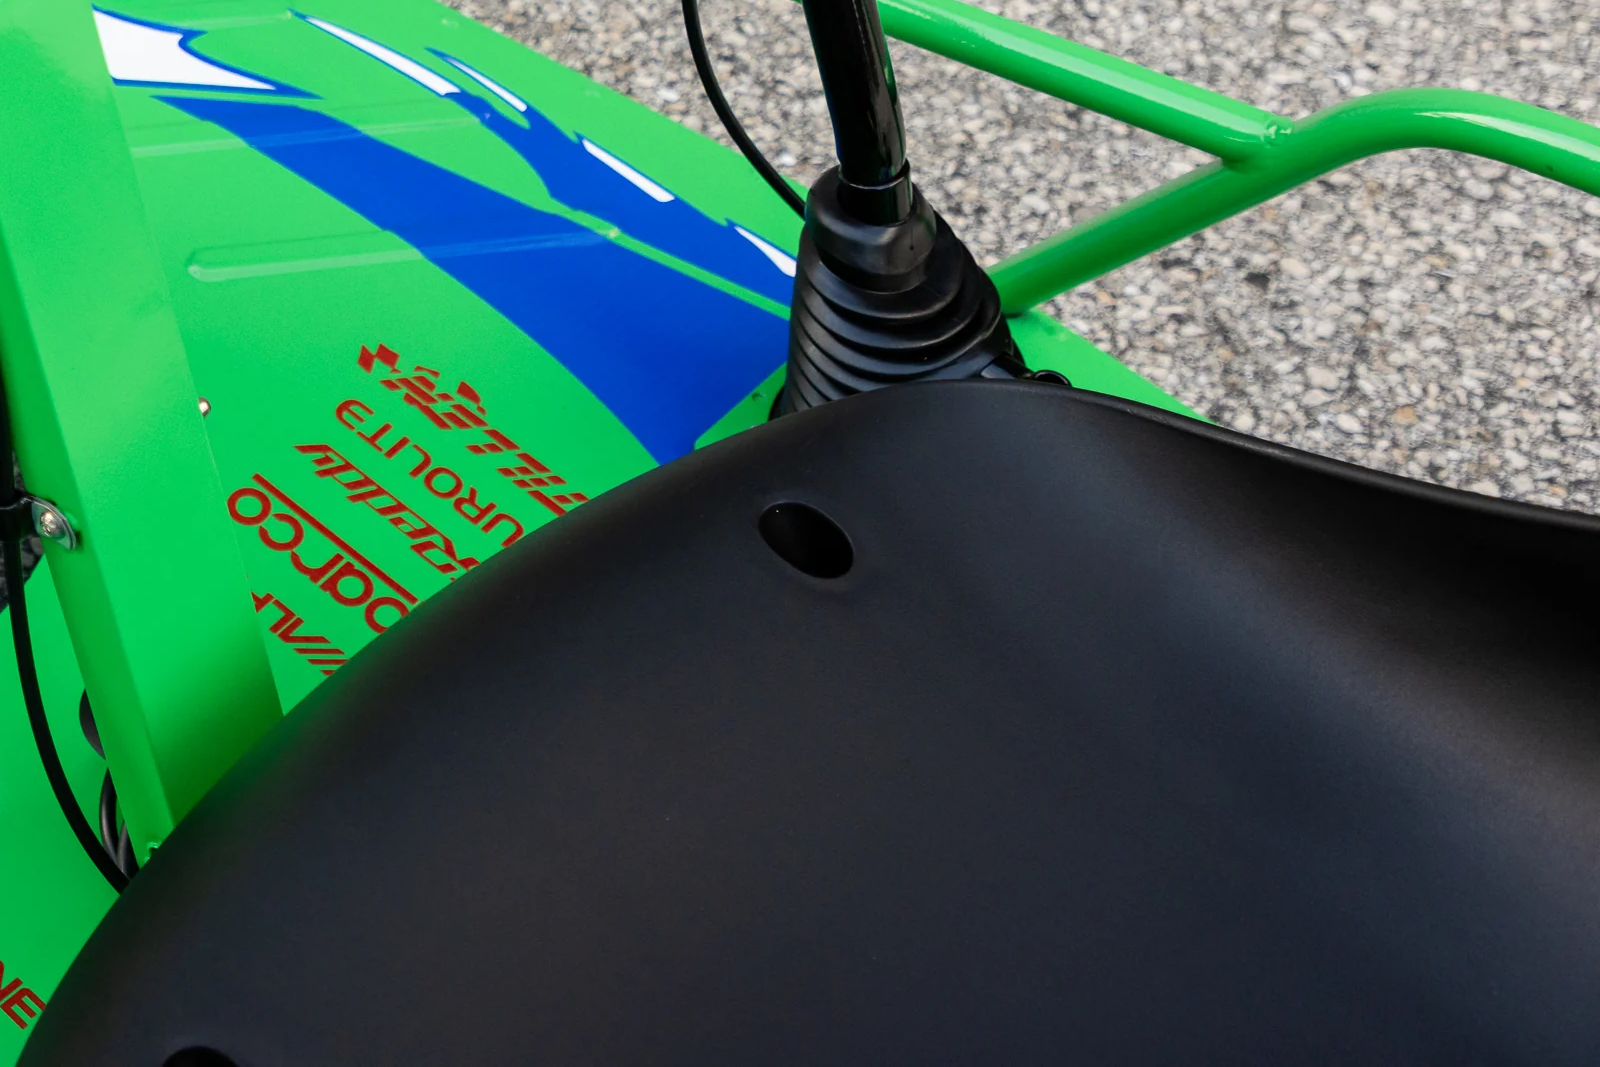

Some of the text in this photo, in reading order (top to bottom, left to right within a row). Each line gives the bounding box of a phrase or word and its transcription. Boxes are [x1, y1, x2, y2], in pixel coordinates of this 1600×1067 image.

[293, 444, 481, 574] Reddy
[334, 399, 524, 548] UROLITE
[379, 375, 590, 516] TILLEN
[227, 487, 410, 634] parco
